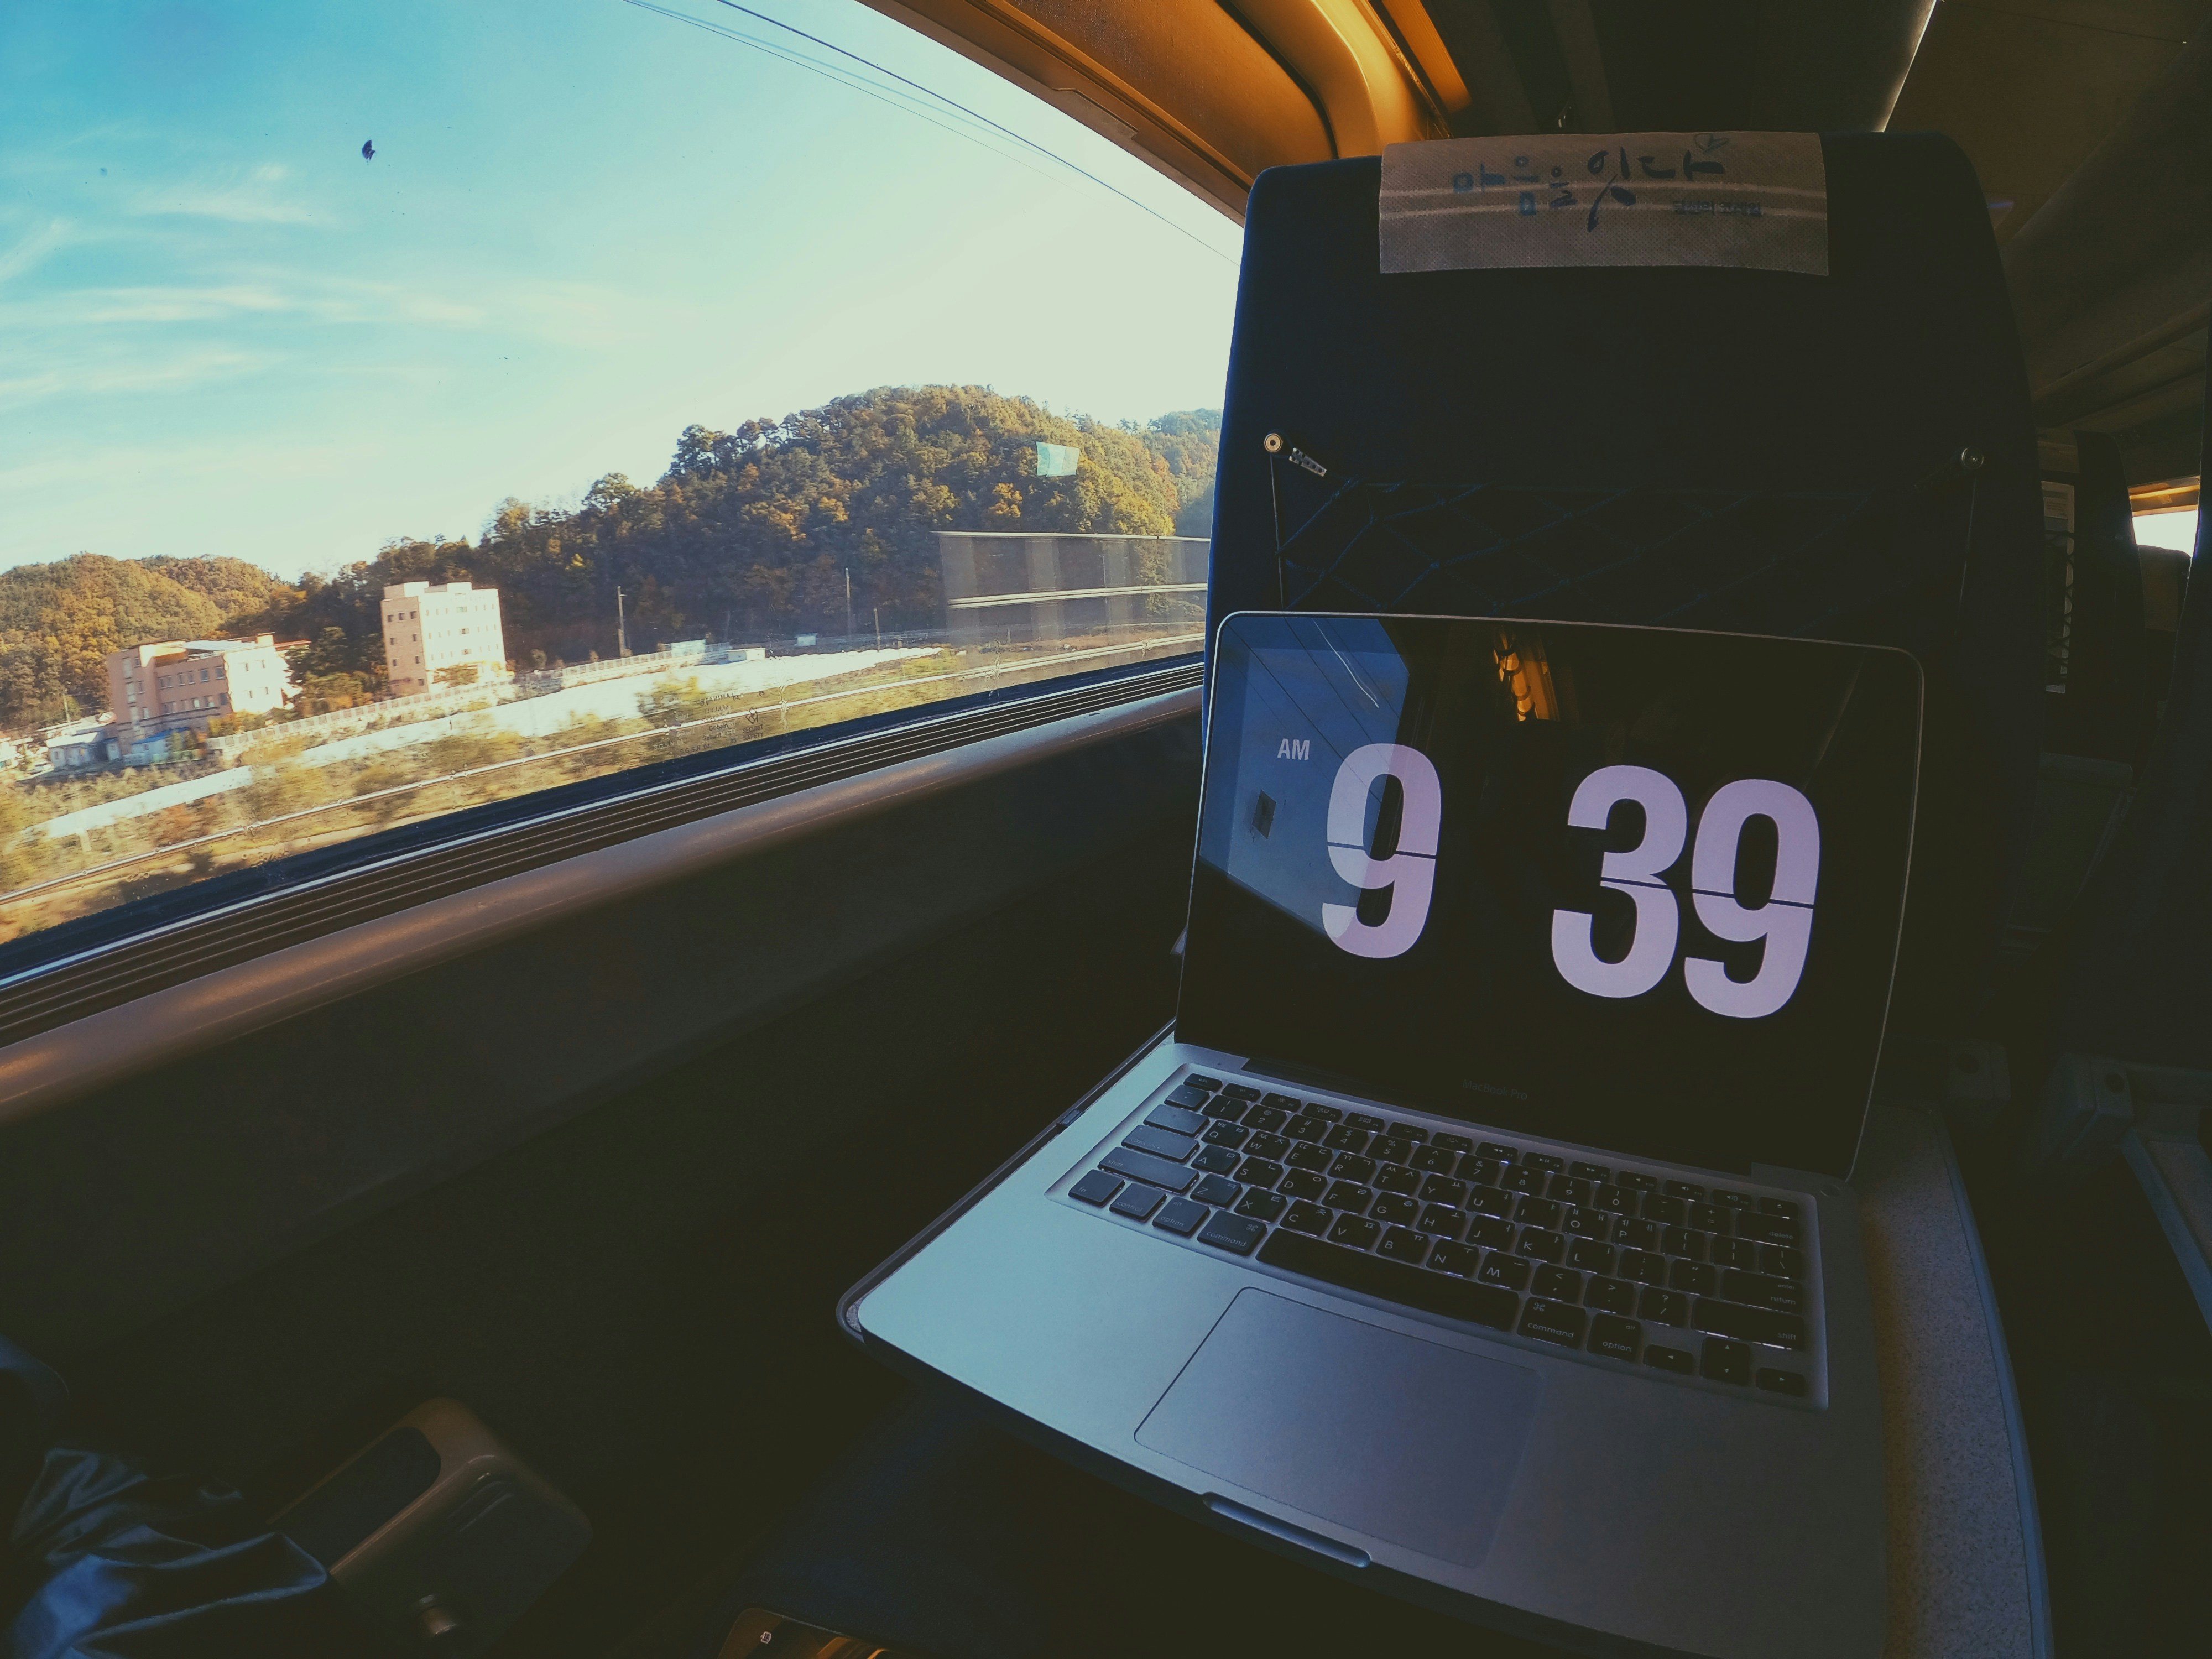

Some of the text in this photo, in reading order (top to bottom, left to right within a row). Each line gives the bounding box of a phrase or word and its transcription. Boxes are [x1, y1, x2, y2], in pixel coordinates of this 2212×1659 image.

[1452, 146, 1725, 233] 마음을 잇다
[1277, 738, 1310, 760] AM
[1322, 743, 1442, 958] 9
[1551, 765, 1821, 1019] 39
[1462, 1079, 1528, 1100] MacBook Pro
[1250, 1141, 1262, 1150] W
[1108, 1159, 1123, 1167] shift
[1117, 1201, 1144, 1212] control
[1241, 1201, 1254, 1209] X
[1161, 1216, 1184, 1227] option
[1424, 1218, 1435, 1227] H
[1338, 1227, 1347, 1235] V
[1768, 1231, 1793, 1239] delete
[1207, 1231, 1247, 1247] command
[1524, 1241, 1533, 1250] K
[1434, 1254, 1446, 1264] N
[1574, 1253, 1580, 1261] L
[1486, 1267, 1500, 1277] M
[1771, 1295, 1796, 1305] return
[1527, 1322, 1574, 1338] command
[1603, 1340, 1631, 1352] option
